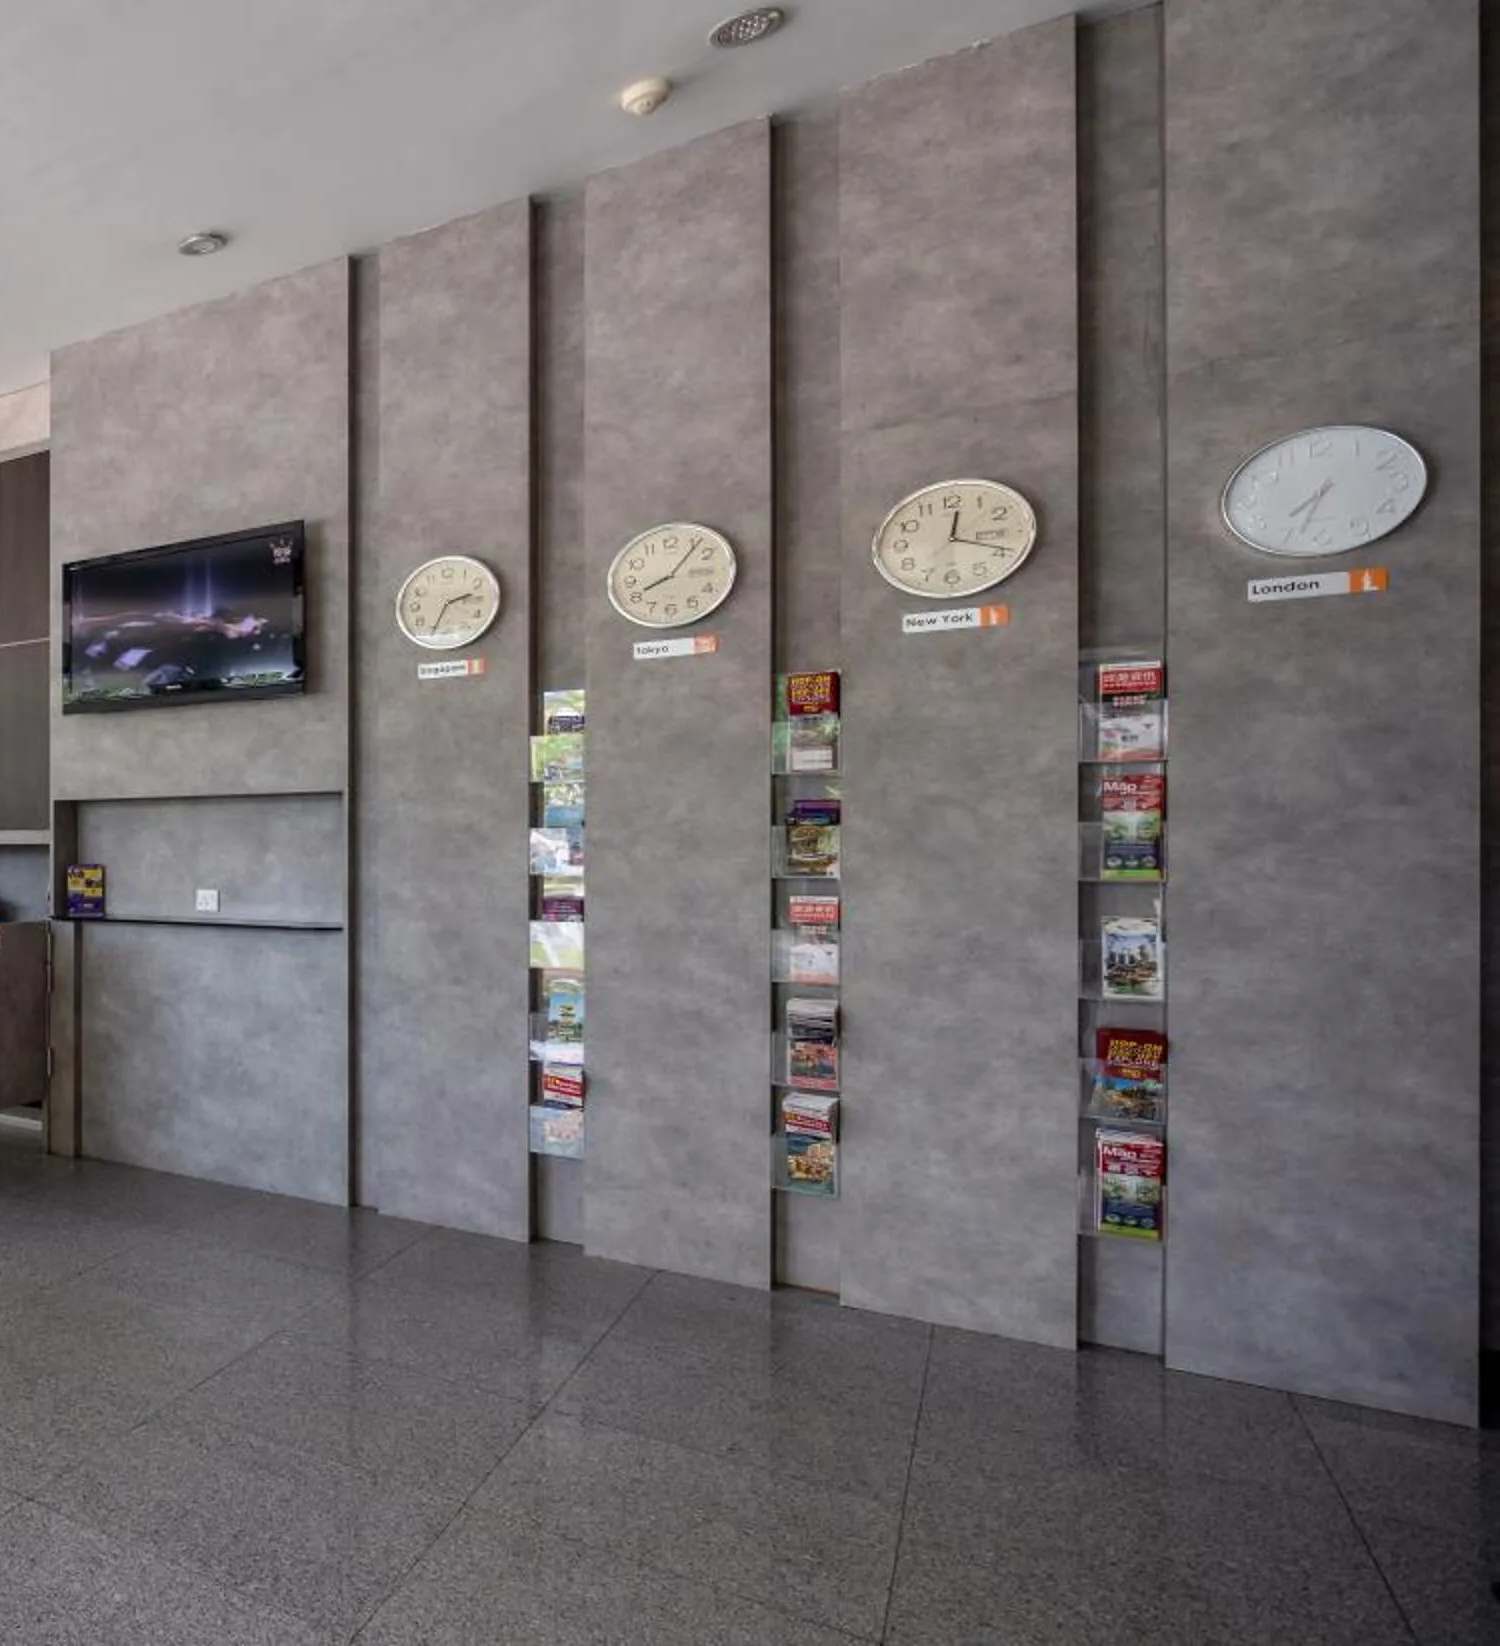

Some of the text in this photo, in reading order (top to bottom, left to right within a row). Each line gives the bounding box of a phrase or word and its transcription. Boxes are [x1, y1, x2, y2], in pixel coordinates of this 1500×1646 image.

[943, 495, 962, 509] 12
[976, 496, 983, 509] 1
[1375, 498, 1396, 515] 4
[918, 503, 933, 517] 11
[992, 506, 1008, 521] 2
[901, 519, 920, 533] 10
[645, 543, 655, 556] 11
[662, 536, 678, 549] 12
[701, 547, 714, 560] 2
[901, 557, 916, 571] 8
[973, 562, 988, 576] 5
[920, 568, 935, 582] 7
[944, 569, 961, 584] 6
[701, 582, 713, 593] 4
[1251, 579, 1320, 596] London
[629, 591, 642, 604] 8
[646, 601, 657, 615] 7
[905, 613, 973, 627] New York
[1103, 781, 1137, 793] Map
[1103, 1145, 1137, 1160] Map
